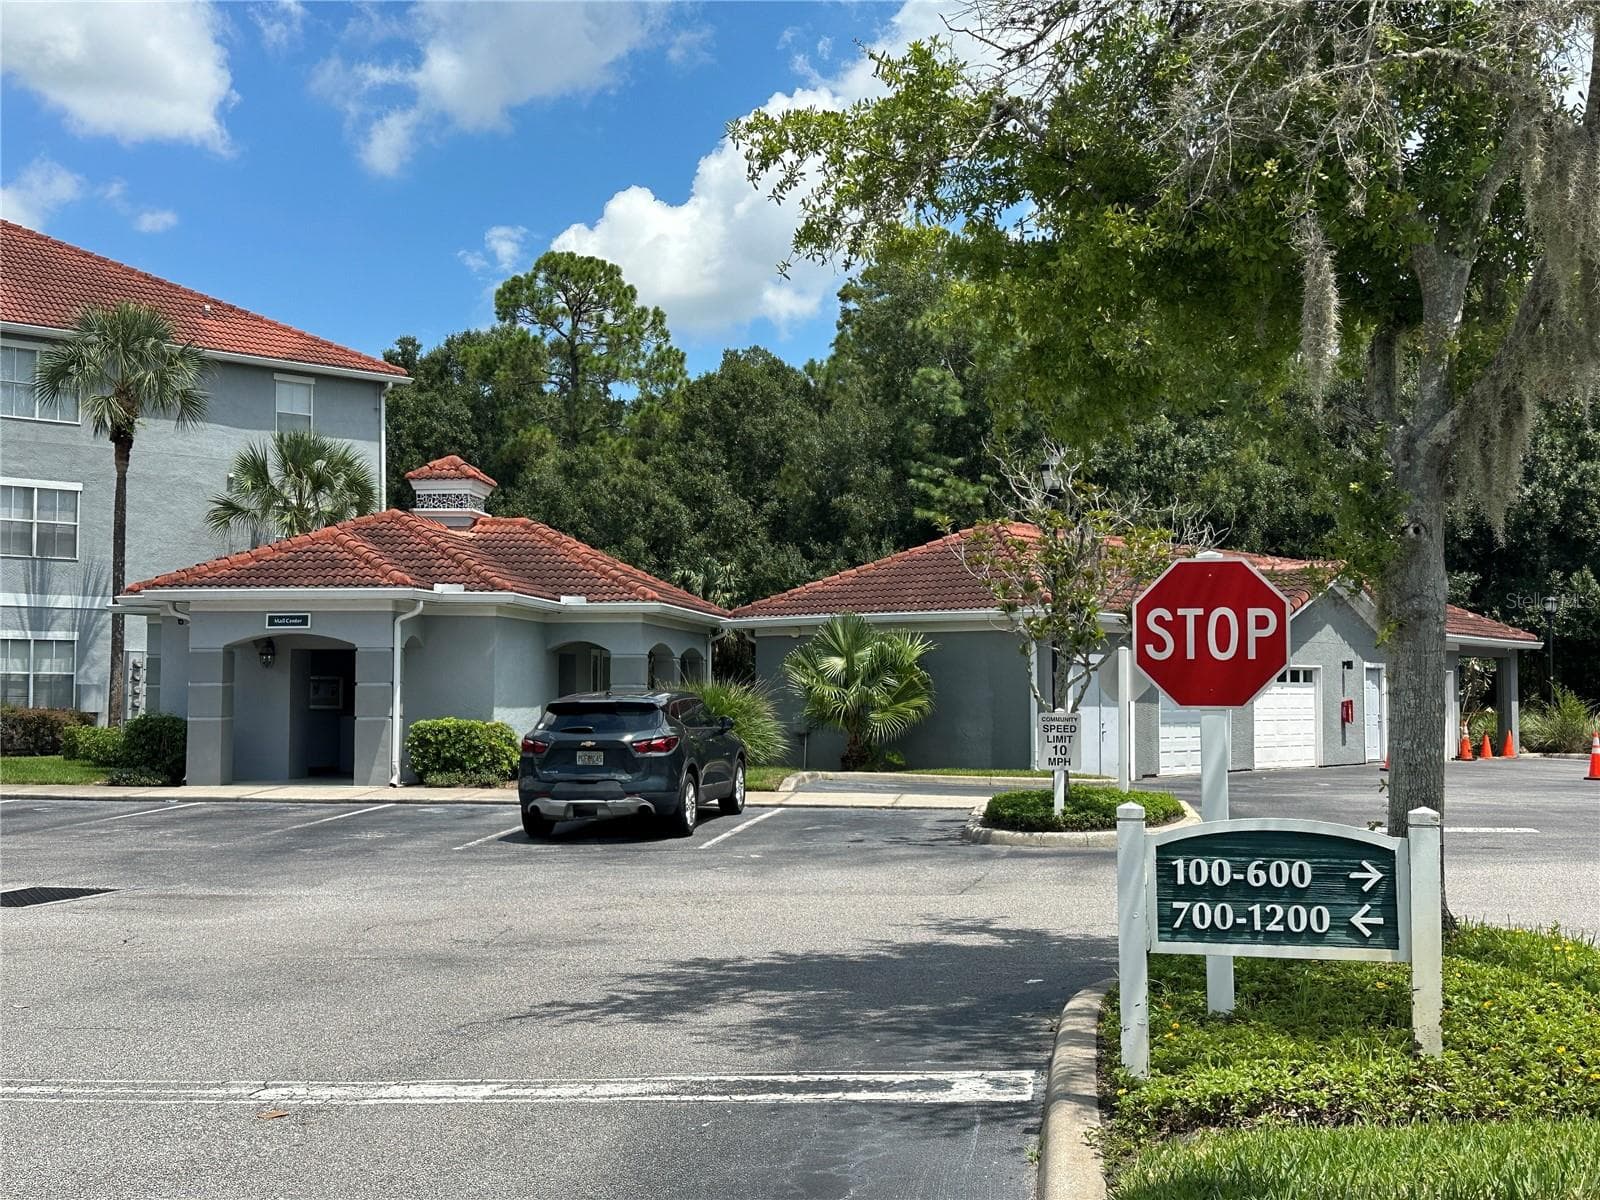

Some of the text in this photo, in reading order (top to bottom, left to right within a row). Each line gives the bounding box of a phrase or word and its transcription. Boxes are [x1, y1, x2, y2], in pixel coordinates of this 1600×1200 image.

[1145, 606, 1278, 661] STOP
[1042, 724, 1077, 734] SPEED
[1046, 735, 1073, 744] LIMIT
[1052, 745, 1067, 756] 10
[1047, 757, 1072, 767] MPH
[1171, 858, 1312, 889] 100-600
[1171, 901, 1331, 934] 700-1200
